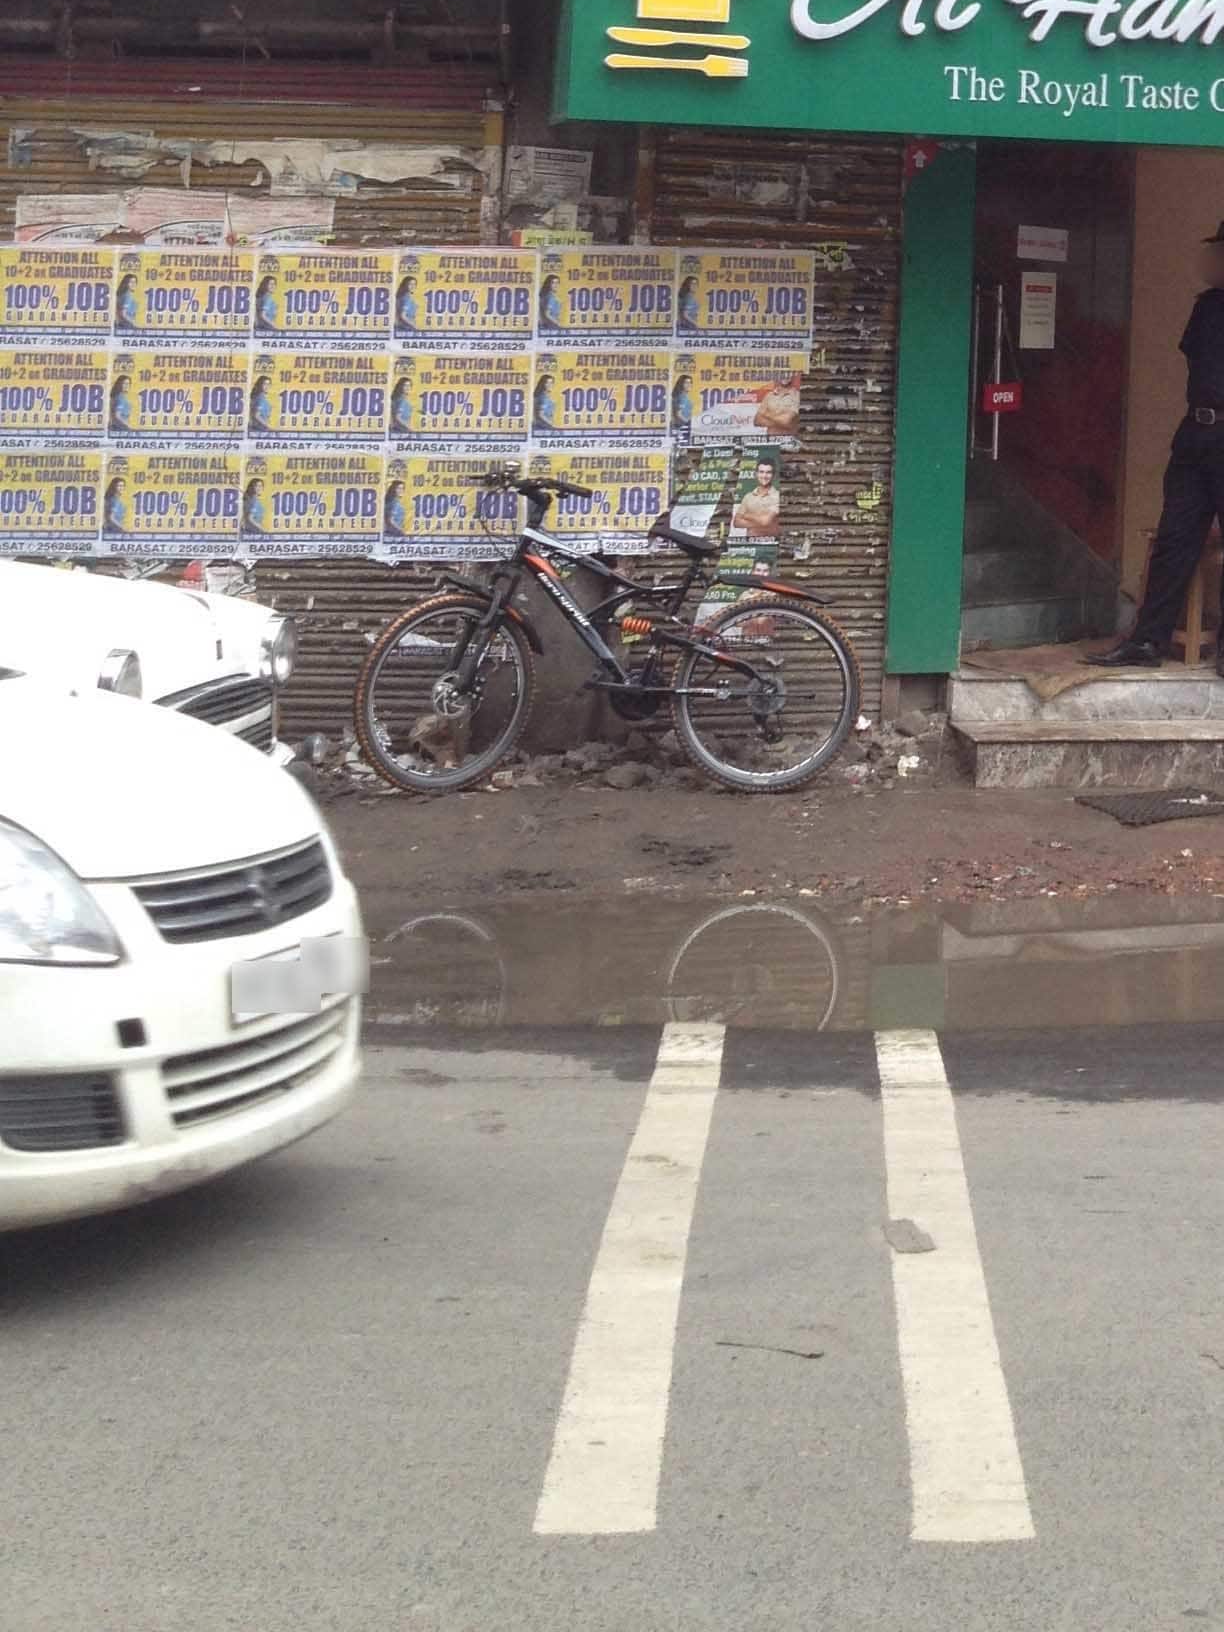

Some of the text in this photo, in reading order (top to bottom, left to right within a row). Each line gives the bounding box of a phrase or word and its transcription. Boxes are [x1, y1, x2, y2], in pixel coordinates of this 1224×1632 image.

[944, 66, 1006, 103] The
[1017, 70, 1109, 113] Royal
[1120, 74, 1199, 111] Taste
[19, 252, 97, 264] ATTENTION ALL
[159, 255, 238, 267] ATTENTION ALL
[299, 257, 377, 269] ATTENTION ALL
[439, 257, 517, 269] ATTENTION ALL
[582, 255, 659, 266] ATTENTION ALL
[719, 257, 795, 269] ATTENTION ALL
[49, 266, 112, 278] GRADUATES
[189, 270, 253, 281] GRADUATES
[329, 271, 392, 283] GRADUATES
[468, 271, 532, 283] GRADUATES
[611, 269, 675, 280] GRADUATES
[748, 271, 810, 283] GRADUATES
[5, 283, 109, 310] 100% JOB
[145, 286, 249, 313] 100% JOB
[284, 287, 389, 314] 100% JOB
[424, 287, 529, 314] 100% JOB
[568, 285, 672, 311] 100% JOB
[706, 287, 807, 313] 100% JOB
[402, 341, 457, 349] BARASAT
[13, 354, 92, 366] ATTENTION ALL
[153, 356, 232, 368] ATTENTION ALL
[294, 357, 373, 369] ATTENTION ALL
[434, 358, 512, 370] ATTENTION ALL
[576, 355, 654, 366] ATTENTION ALL
[713, 356, 792, 368] ATTENTION ALL
[43, 368, 107, 380] GRADUATES
[183, 370, 247, 382] GRADUATES
[324, 372, 388, 383] GRADUATES
[464, 372, 527, 384] GRADUATES
[606, 368, 669, 380] GRADUATES
[59, 384, 103, 412] JOB
[139, 387, 243, 414] 100% JOB
[279, 388, 384, 415] 100% JOB
[419, 389, 524, 416] 100% JOB
[562, 384, 666, 412] 100% JOB
[993, 391, 1014, 405] OPEN
[397, 443, 452, 451] BARASAT
[5, 456, 84, 468] ATTENTION ALL
[148, 458, 226, 470] ATTENTION ALL
[286, 458, 365, 470] ATTENTION ALL
[427, 461, 483, 472] ATTENTION
[570, 457, 648, 469] ATTENTION ALL
[35, 470, 99, 482] GRADUATES
[177, 472, 241, 484] GRADUATES
[316, 472, 380, 484] GRADUATES
[600, 471, 663, 483] GRADUATES
[0, 486, 96, 514] 00% JOB
[133, 489, 238, 516] 100% JOB
[272, 488, 377, 516] 100% JOB
[413, 494, 466, 518] 100%
[616, 487, 660, 514] JOB
[558, 516, 652, 527] GUARANTEE
